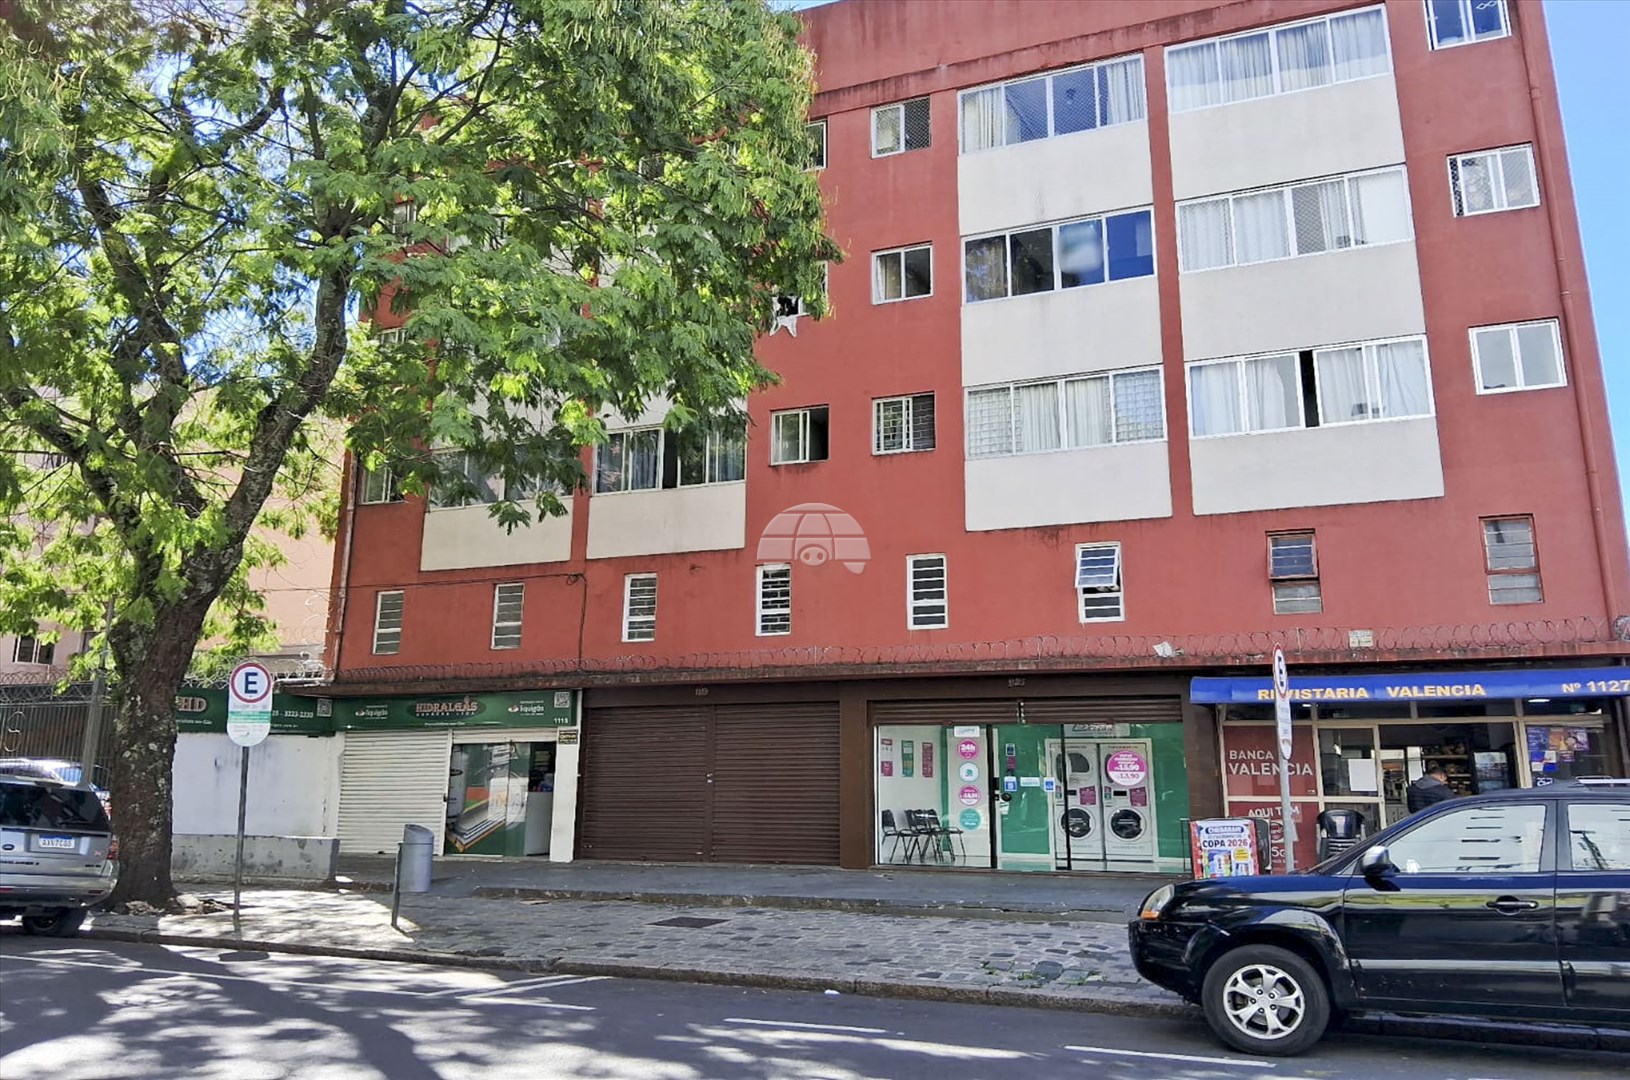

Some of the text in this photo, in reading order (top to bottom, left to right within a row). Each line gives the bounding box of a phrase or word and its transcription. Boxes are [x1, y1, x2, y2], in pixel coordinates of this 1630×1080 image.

[244, 672, 259, 694] E
[1586, 680, 1630, 693] 1127
[1386, 683, 1487, 698] VALENCIA
[1229, 749, 1274, 760] BANCA
[1228, 762, 1313, 776] VALENCIA
[1276, 806, 1300, 817] TM
[1202, 839, 1248, 848] COPA 2026
